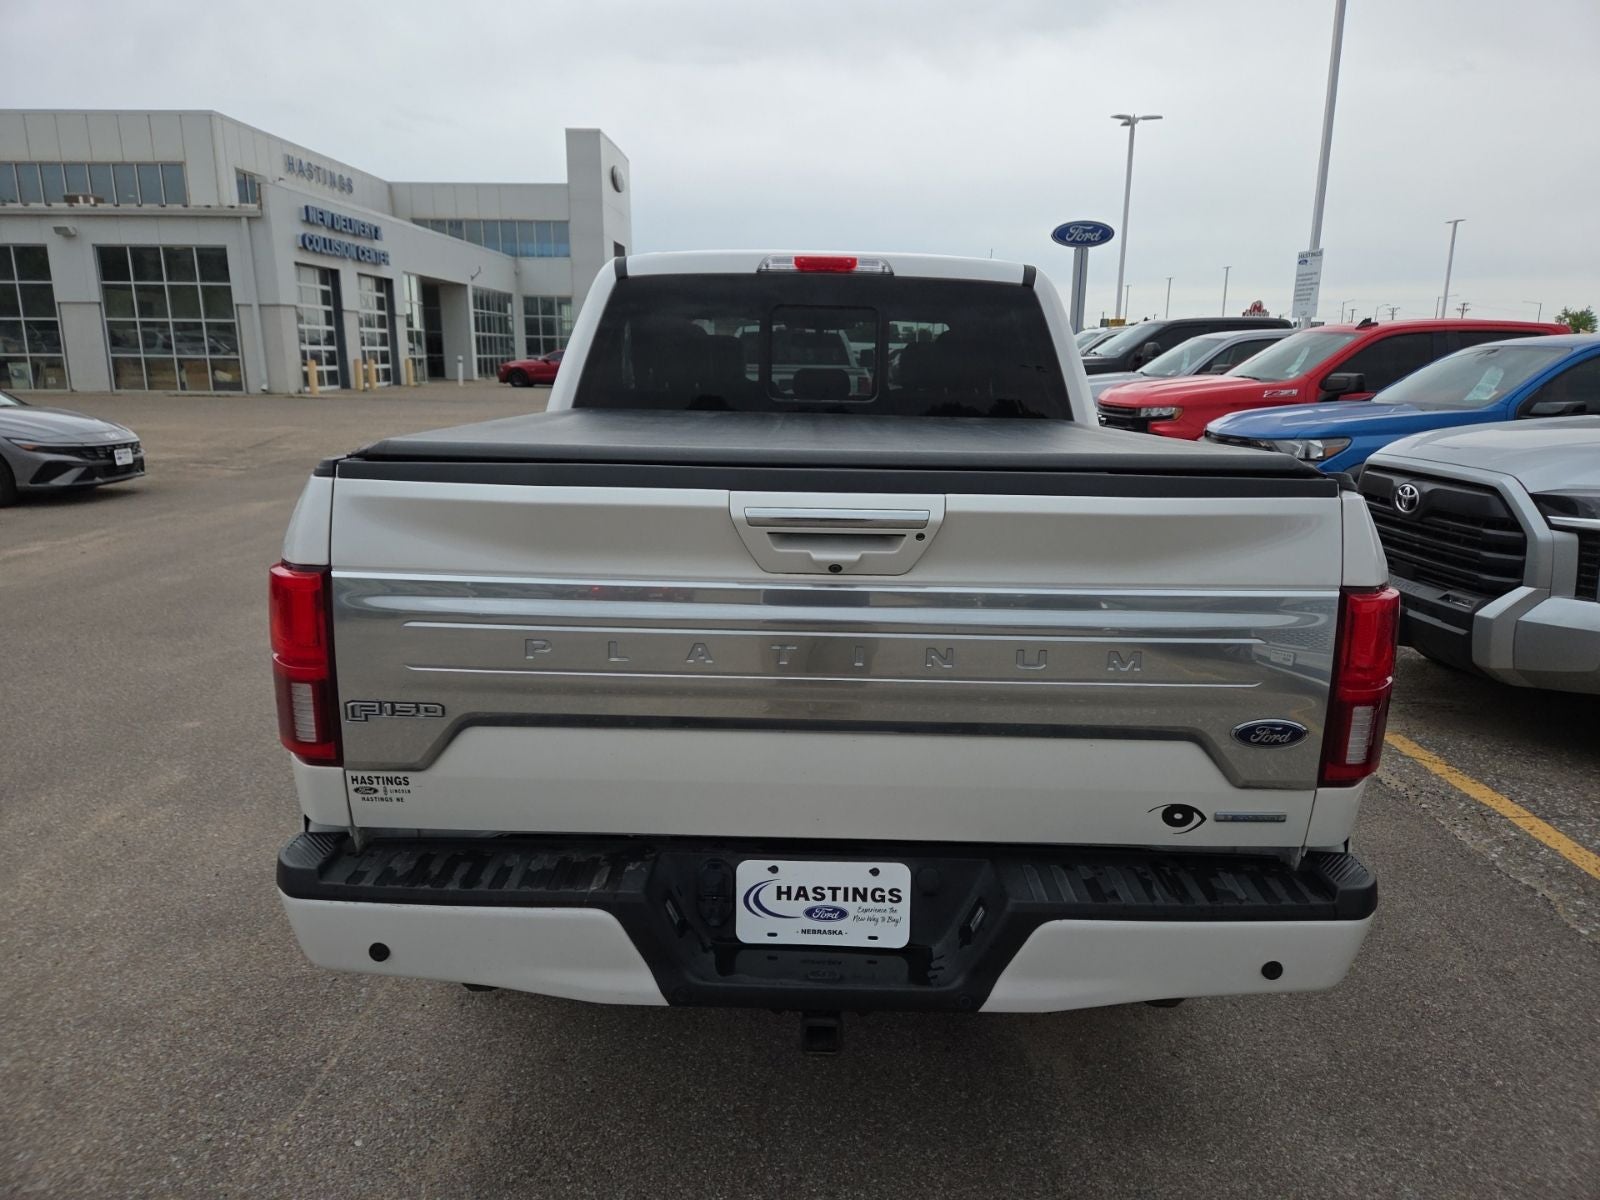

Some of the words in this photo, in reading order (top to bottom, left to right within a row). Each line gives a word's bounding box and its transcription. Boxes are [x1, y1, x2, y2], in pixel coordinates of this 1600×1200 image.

[285, 154, 354, 194] HASTINGS
[304, 205, 333, 230] NEW
[1066, 225, 1103, 241] Ford
[301, 233, 357, 260] COLLISION
[356, 245, 390, 265] CENTER
[525, 639, 1142, 671] PLATINUM
[1251, 727, 1291, 743] Ford
[351, 776, 410, 786] HASTINGS
[776, 886, 903, 904] HASTINGS
[812, 907, 840, 920] Ford
[857, 906, 887, 914] Experience
